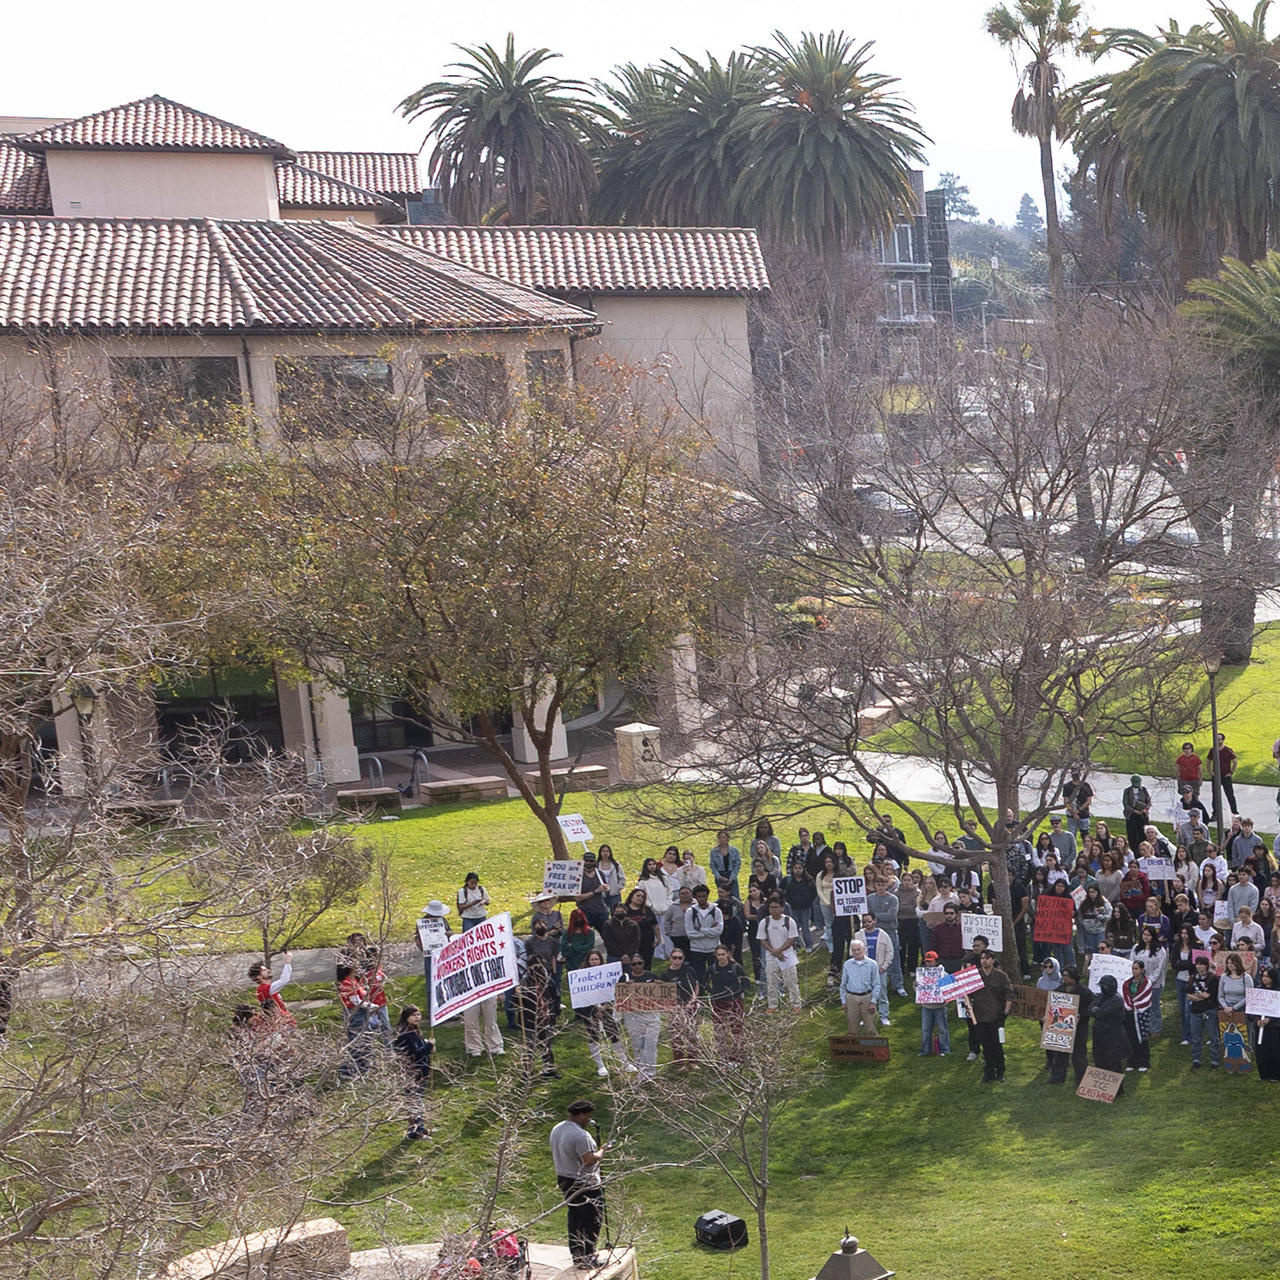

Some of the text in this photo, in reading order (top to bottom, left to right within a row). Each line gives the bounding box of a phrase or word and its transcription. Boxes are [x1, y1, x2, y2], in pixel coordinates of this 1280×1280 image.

[544, 882, 566, 890] SPEAK
[835, 878, 863, 895] STOP
[836, 896, 865, 906] ICE TERROR
[843, 904, 861, 914] NOW!
[963, 915, 999, 928] JUSTICE
[476, 923, 495, 942] AND
[963, 926, 1000, 937] FOR VICTIMS
[436, 940, 497, 980] WORKERS RIGHTS
[443, 968, 473, 1001] STRUGGLE
[470, 962, 486, 987] ONE
[484, 956, 506, 983] FIGHT
[570, 970, 622, 986] Protect our
[616, 983, 676, 998] ICE KKK IDF
[1021, 1003, 1037, 1017] THE
[1045, 1032, 1055, 1042] ICE
[1087, 1070, 1120, 1084] ABOLISH
[1092, 1079, 1110, 1092] ICE
